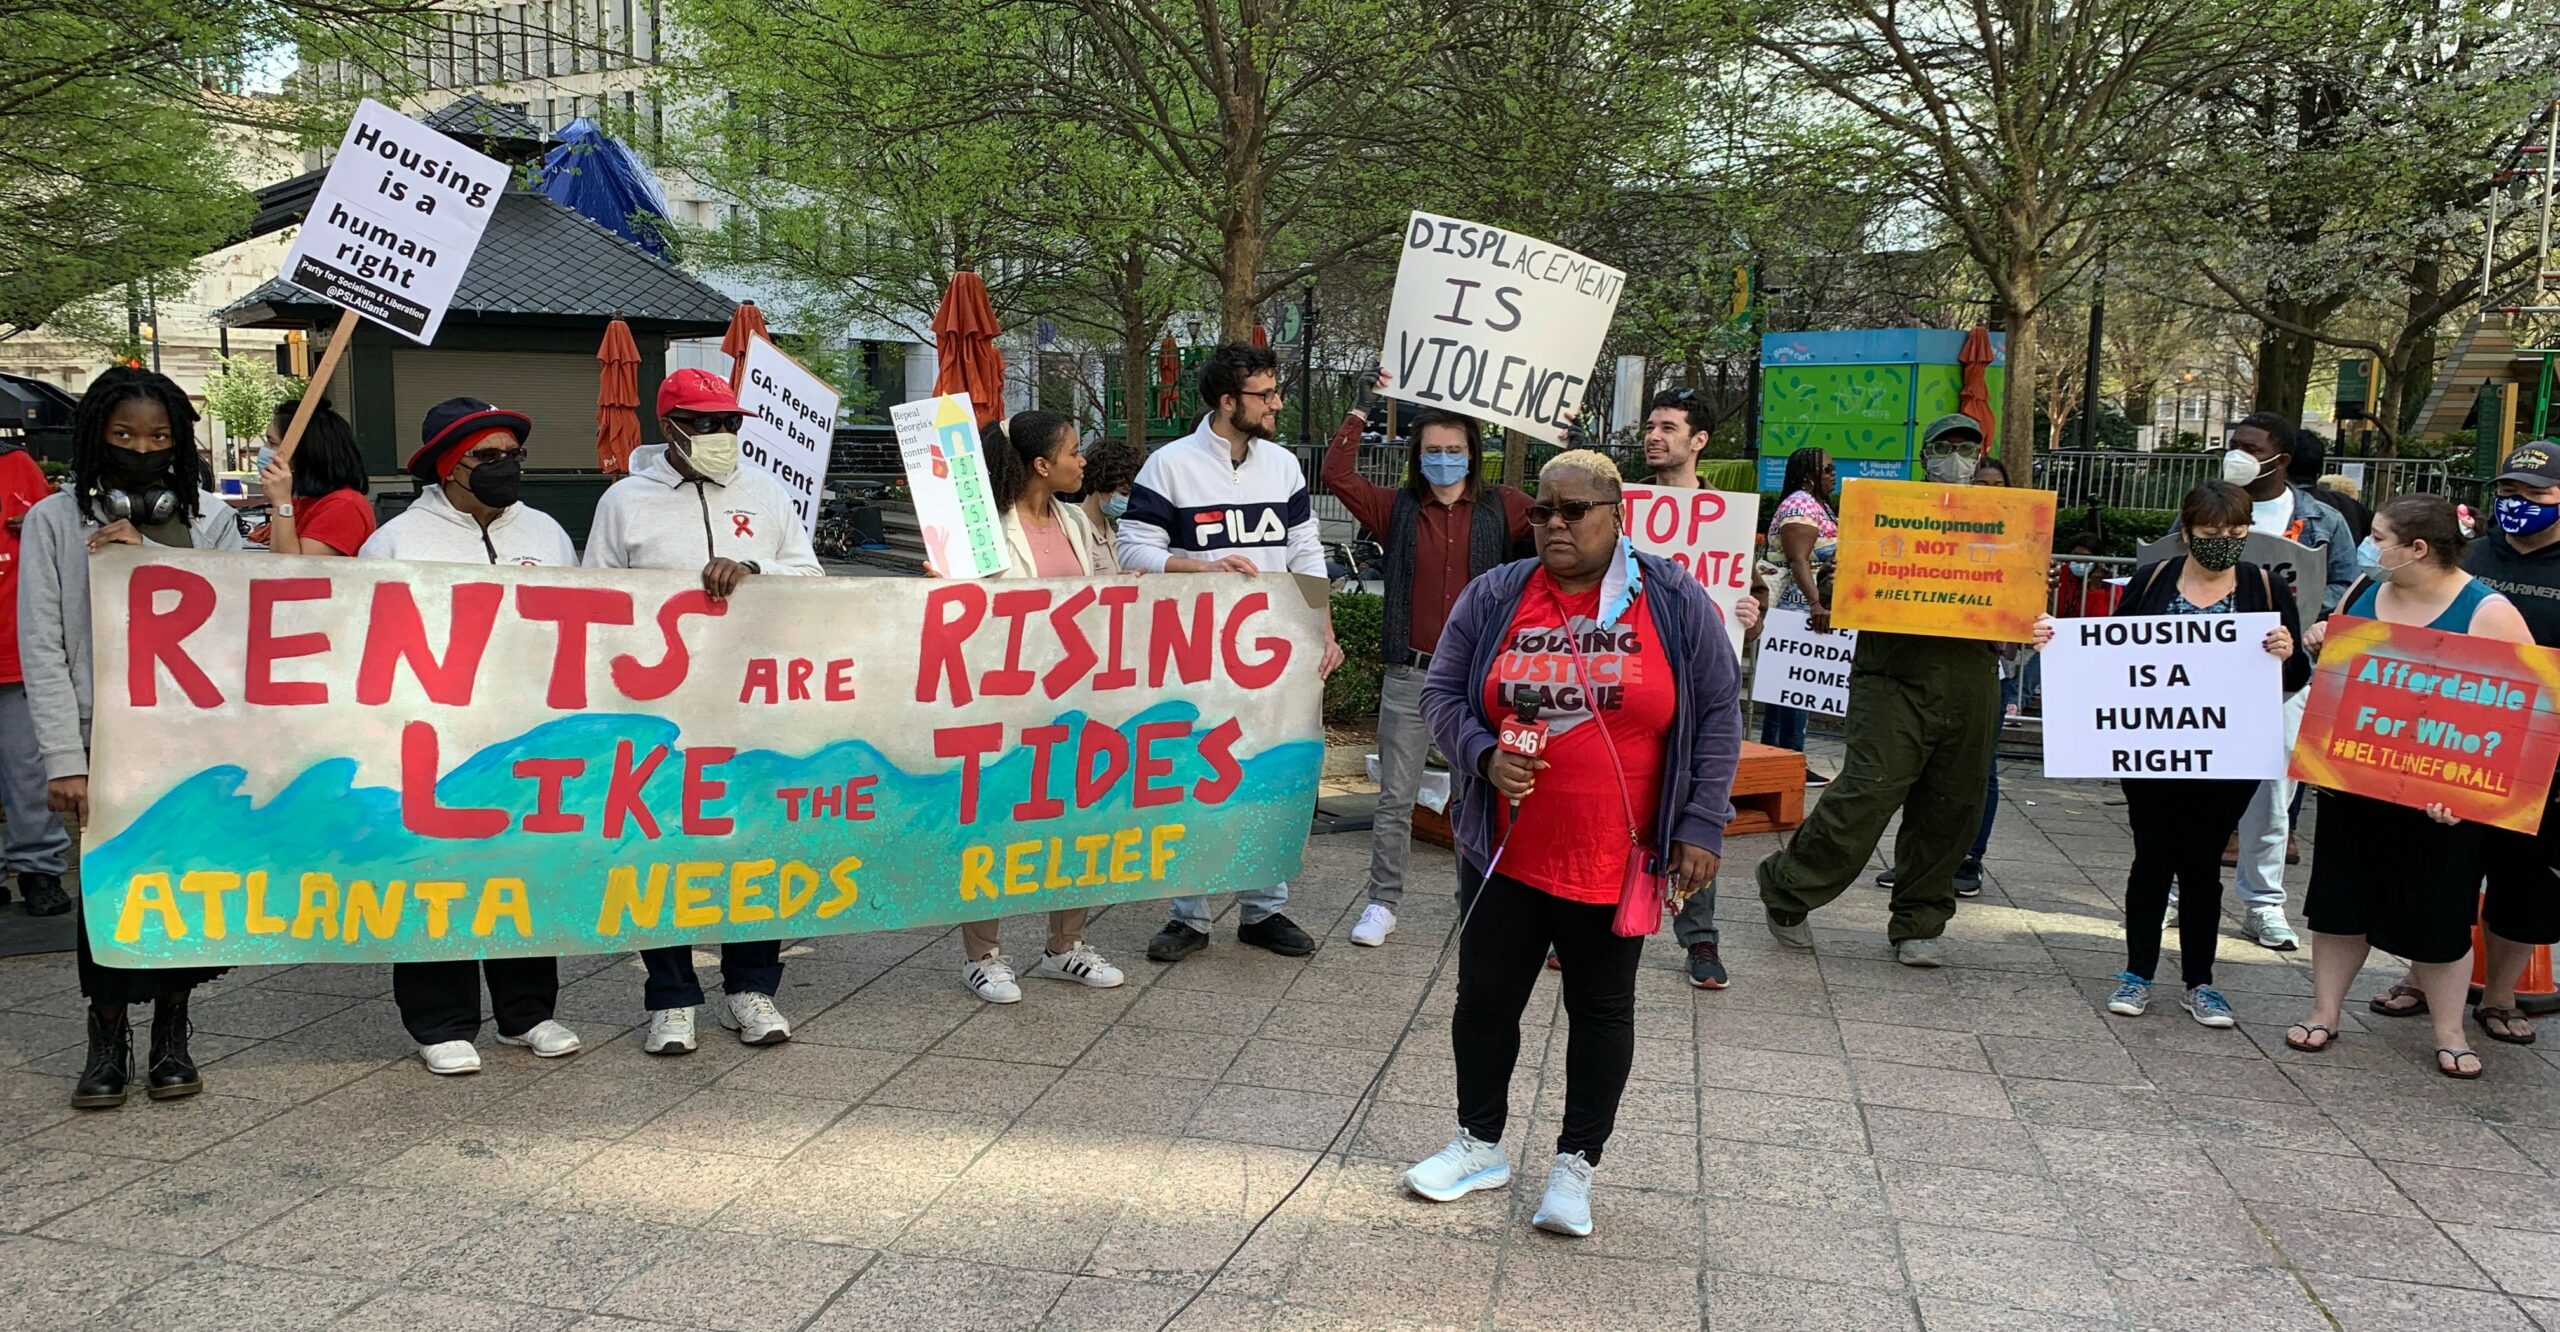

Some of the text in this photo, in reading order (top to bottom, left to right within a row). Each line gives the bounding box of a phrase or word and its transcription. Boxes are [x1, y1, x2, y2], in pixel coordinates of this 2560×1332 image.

[354, 123, 492, 208] Housing
[378, 170, 437, 216] is a
[328, 202, 437, 267] human
[336, 241, 415, 289] right
[1409, 218, 1623, 304] DISPLACEMENT
[301, 260, 425, 320] Party for Socialism & Liberation
[326, 285, 389, 319] @PSLAtlanta
[1434, 278, 1522, 332] IS
[1399, 330, 1584, 428] VIOLENCE
[750, 368, 777, 397] GA:
[781, 387, 832, 433] Repeal
[893, 408, 920, 422] Repeal
[757, 403, 816, 453] the ban
[896, 419, 933, 434] Georgia's
[901, 434, 918, 446] rent
[741, 440, 814, 496] on rent
[903, 445, 931, 458] control
[906, 460, 921, 471] ban
[1193, 507, 1286, 547] FILA
[1622, 489, 1726, 547] TOP
[1874, 513, 2005, 535] Development
[1914, 540, 1960, 556] NOT
[1867, 561, 2004, 584] Displacement
[1874, 587, 1993, 607] #BELTLINE4ALL
[127, 563, 1292, 709] RENTS ARE RISING
[1765, 637, 1851, 664] AFFORDA
[2080, 619, 2238, 647] HOUSING
[1500, 652, 1644, 685] USTICE
[2129, 664, 2191, 688] IS A
[2357, 658, 2526, 711] Affordable
[1780, 690, 1845, 715] FOR AL
[2096, 706, 2227, 730] HUMAN
[1514, 729, 1539, 754] 46
[2354, 705, 2502, 757] For Who?
[401, 716, 1244, 839] LIKE THE TIDES
[2112, 749, 2213, 772] RIGHT
[2332, 738, 2508, 793] #BELTLINEFORALL
[114, 823, 1186, 943] ATLANTA NEEDS RELIEF
